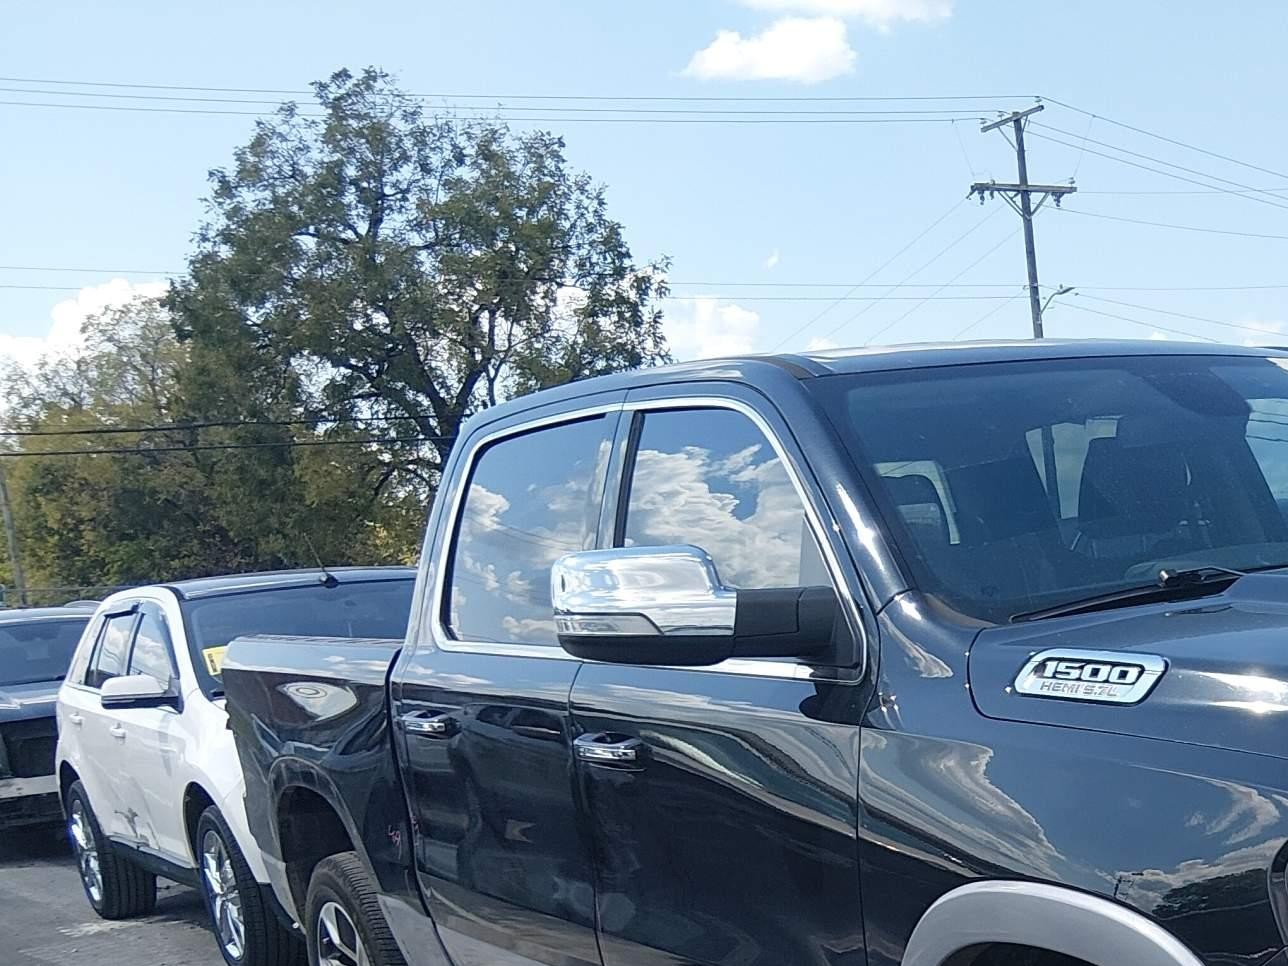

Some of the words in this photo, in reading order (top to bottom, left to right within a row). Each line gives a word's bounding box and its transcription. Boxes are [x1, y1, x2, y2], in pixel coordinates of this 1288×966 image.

[1043, 660, 1142, 684] 1500
[1040, 680, 1081, 694] HEMI
[1083, 683, 1117, 697] 5.7L
